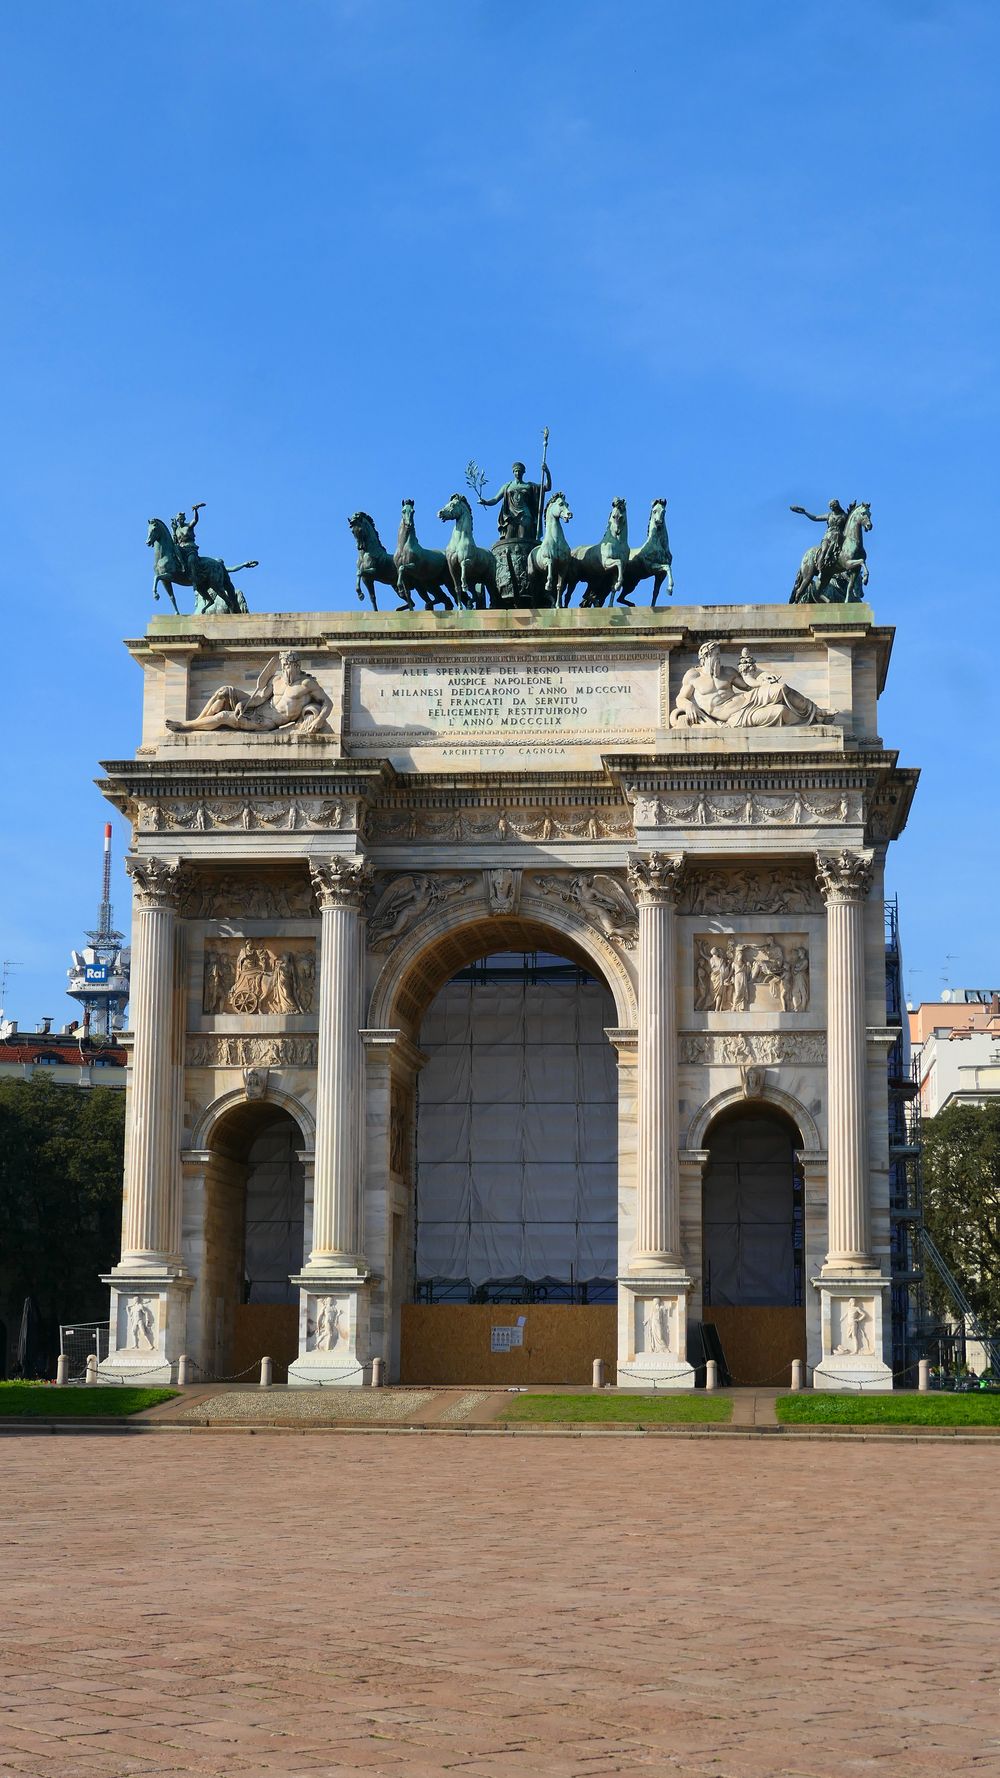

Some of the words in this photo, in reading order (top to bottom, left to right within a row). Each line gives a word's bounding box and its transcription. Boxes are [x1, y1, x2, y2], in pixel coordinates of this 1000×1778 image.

[402, 668, 429, 676] ALLE
[436, 667, 492, 676] SPERANZE
[499, 667, 518, 675] DEL
[526, 666, 560, 674] REGNO
[568, 666, 609, 674] ITALICO
[448, 678, 487, 686] AUSPICE
[494, 677, 552, 685] NAPOLEONE
[392, 688, 443, 696] MILANESI
[451, 687, 520, 696] DEDICARONO
[539, 687, 568, 695] ANNO
[576, 686, 632, 694] MDCCCVII
[437, 699, 443, 707] E
[450, 698, 503, 706] FRANCATI
[513, 697, 527, 705] DA
[428, 708, 500, 717] FELICEMENTE
[508, 707, 588, 715] RESTITUIRONO
[462, 718, 494, 726] ANNO
[501, 717, 562, 725] MDCCCLIX
[518, 747, 566, 755] CAGNOLA
[86, 968, 105, 978] Rai
